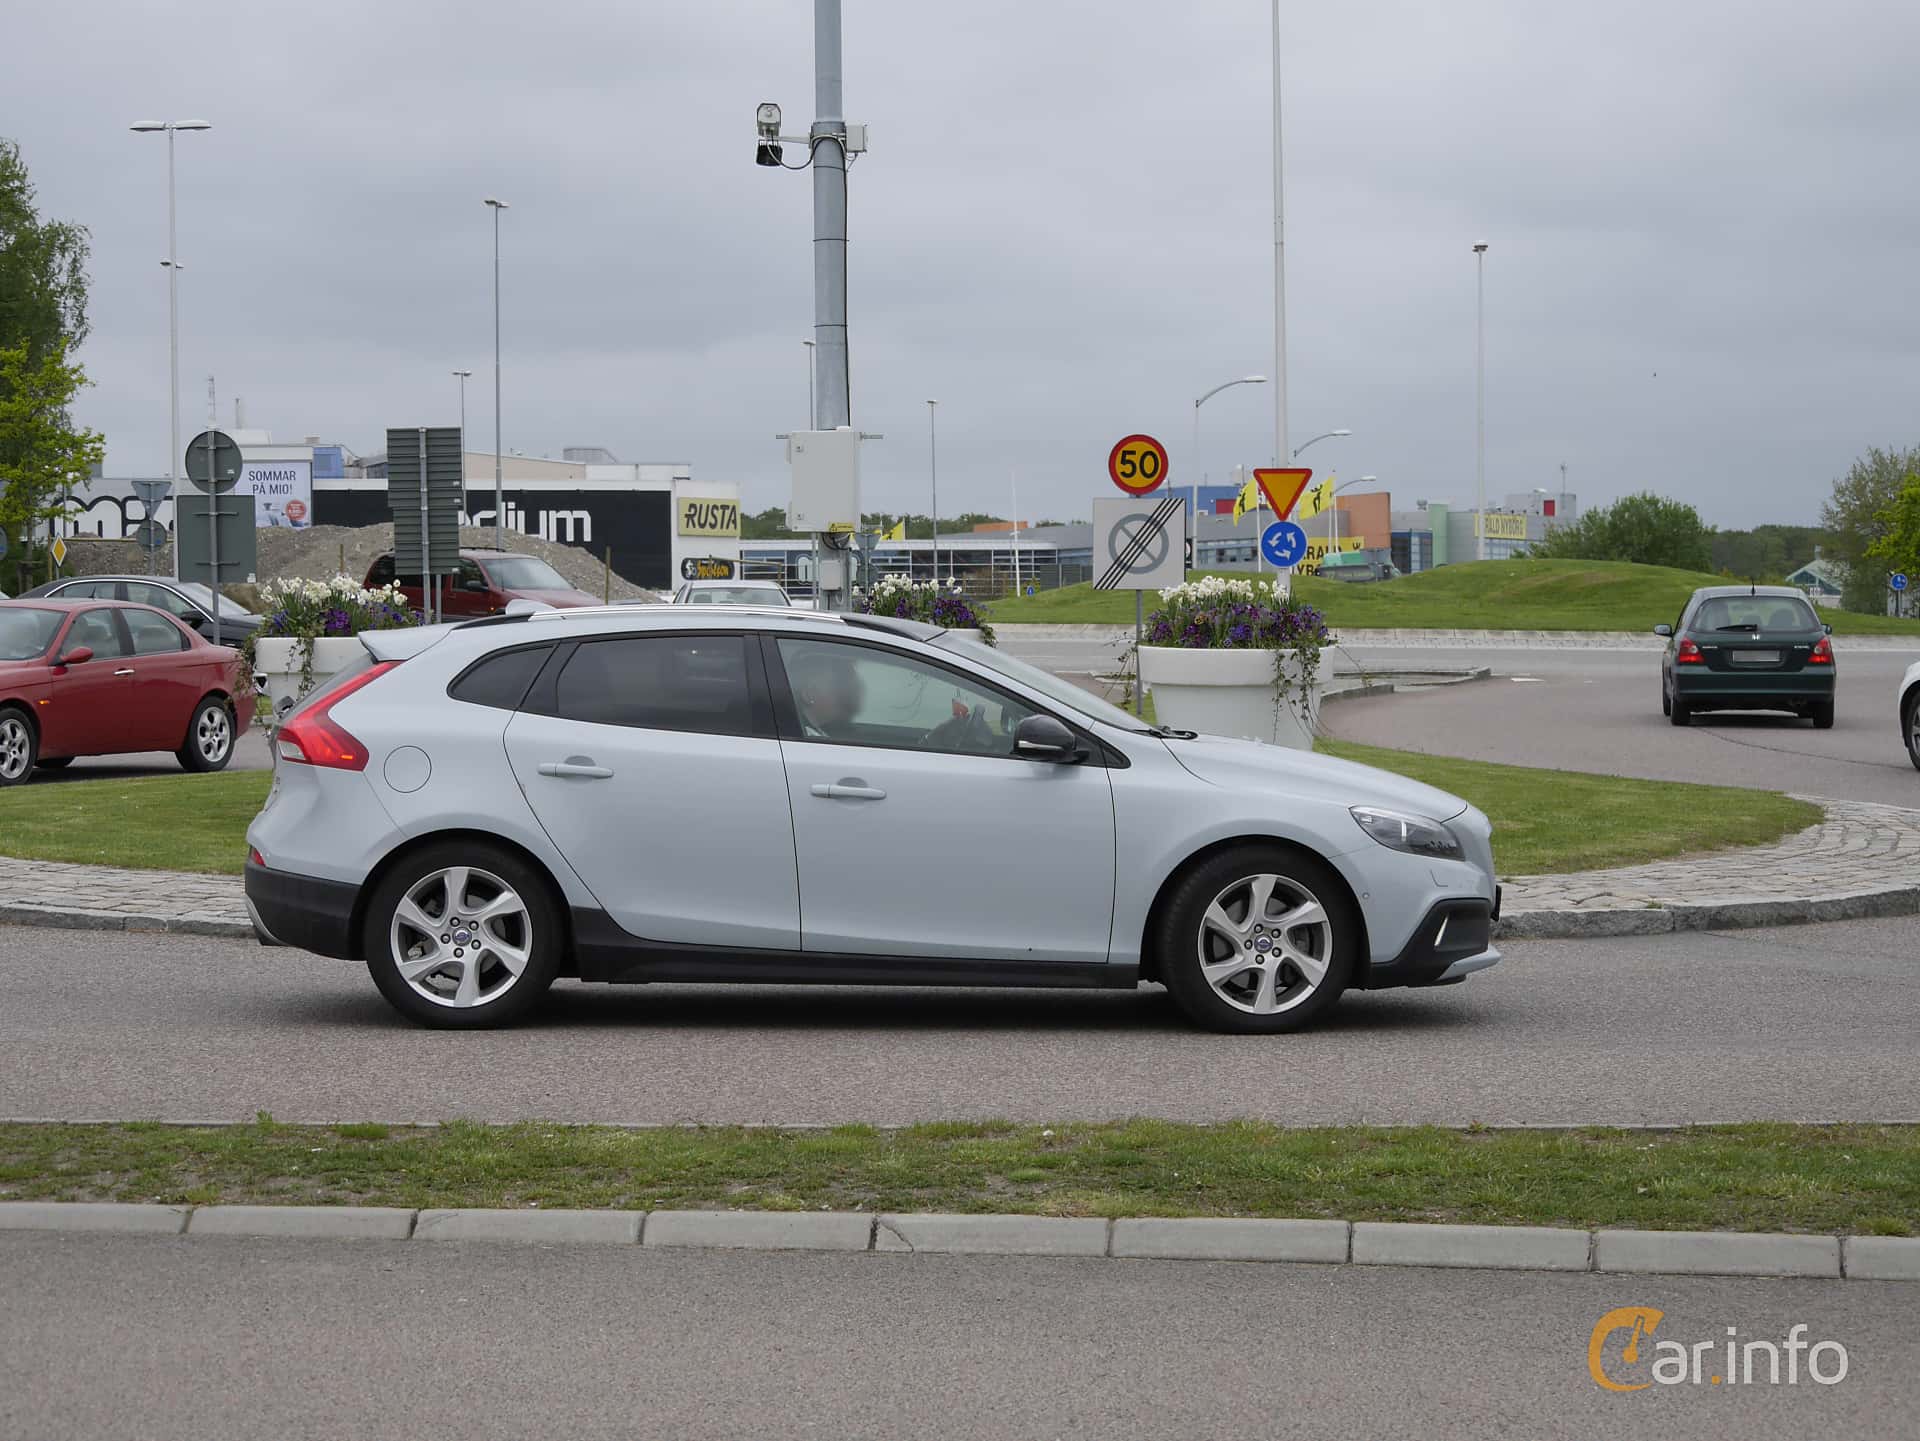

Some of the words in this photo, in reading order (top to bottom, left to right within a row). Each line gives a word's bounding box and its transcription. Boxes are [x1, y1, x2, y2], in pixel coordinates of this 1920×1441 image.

[1119, 450, 1159, 479] 50
[248, 470, 296, 481] SOMMAR
[252, 482, 266, 495] PÅ
[269, 484, 293, 496] MIO!
[684, 503, 737, 530] RUSTA
